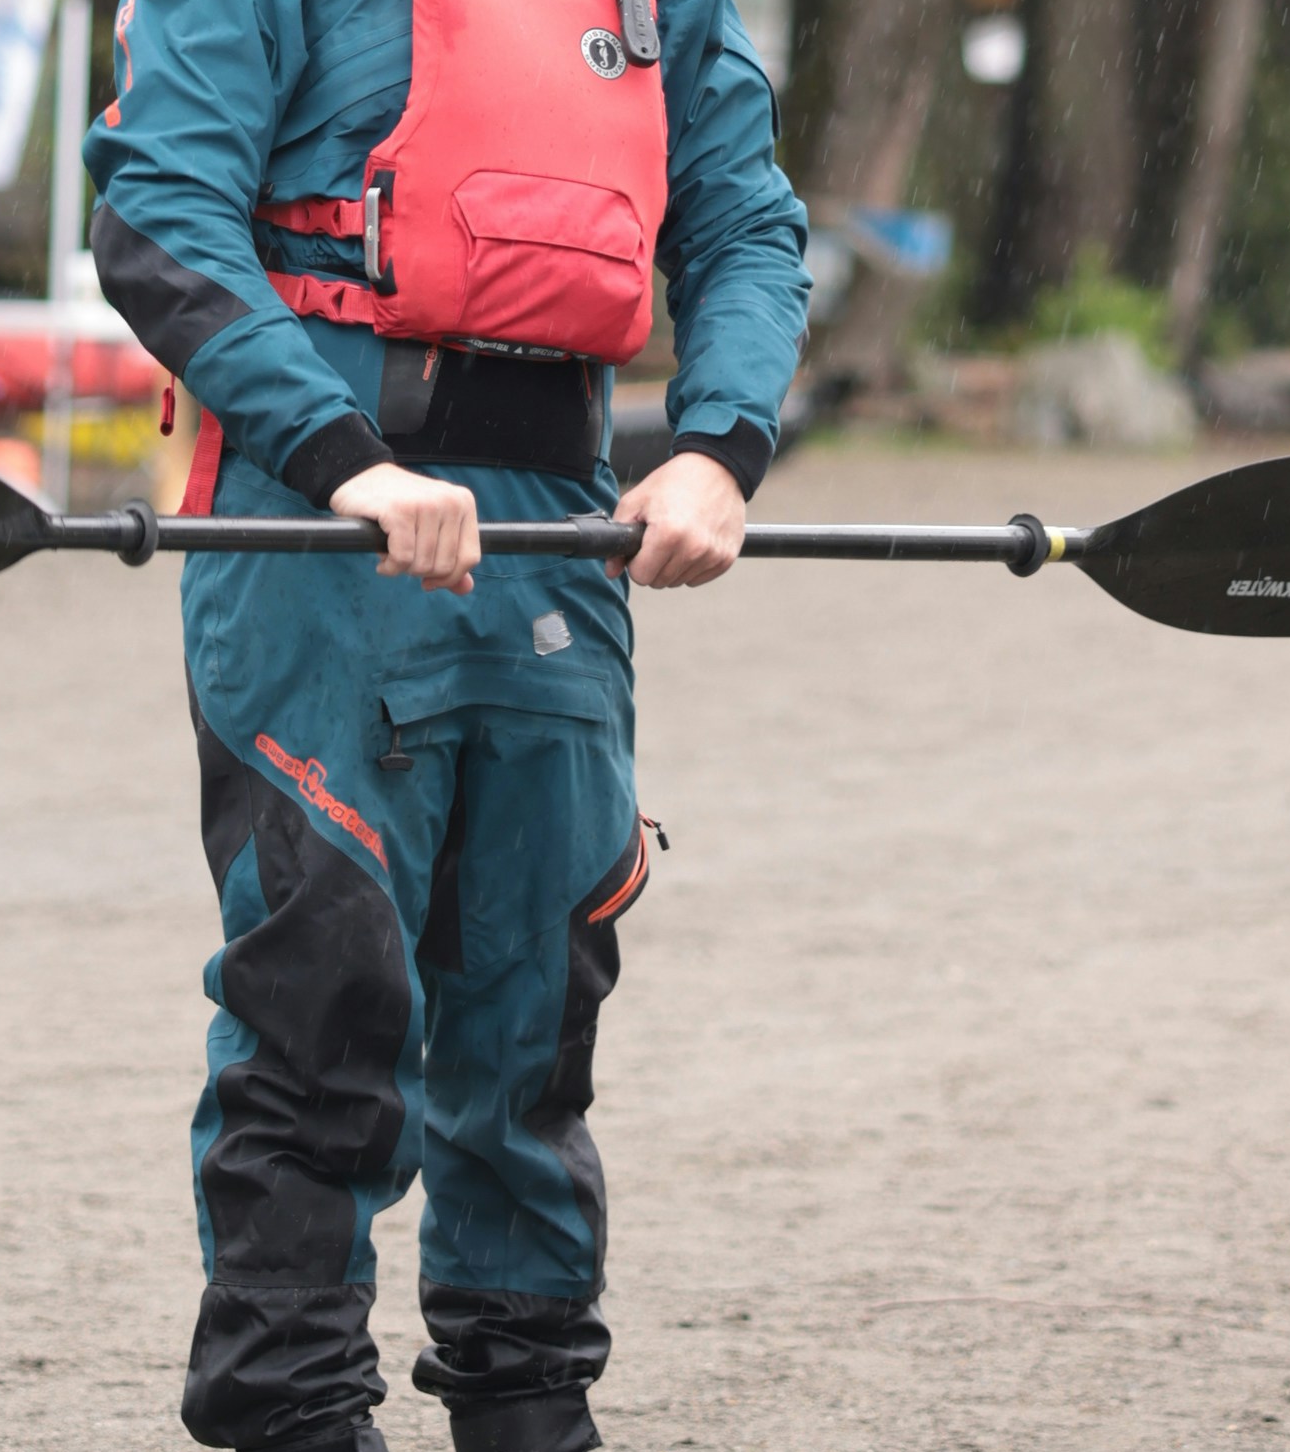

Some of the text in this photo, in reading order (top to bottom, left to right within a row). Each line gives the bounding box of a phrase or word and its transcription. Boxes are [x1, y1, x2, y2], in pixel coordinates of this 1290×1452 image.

[583, 31, 621, 52] MUSTANG
[585, 54, 625, 76] SURVIVAL
[257, 736, 304, 778] sweet
